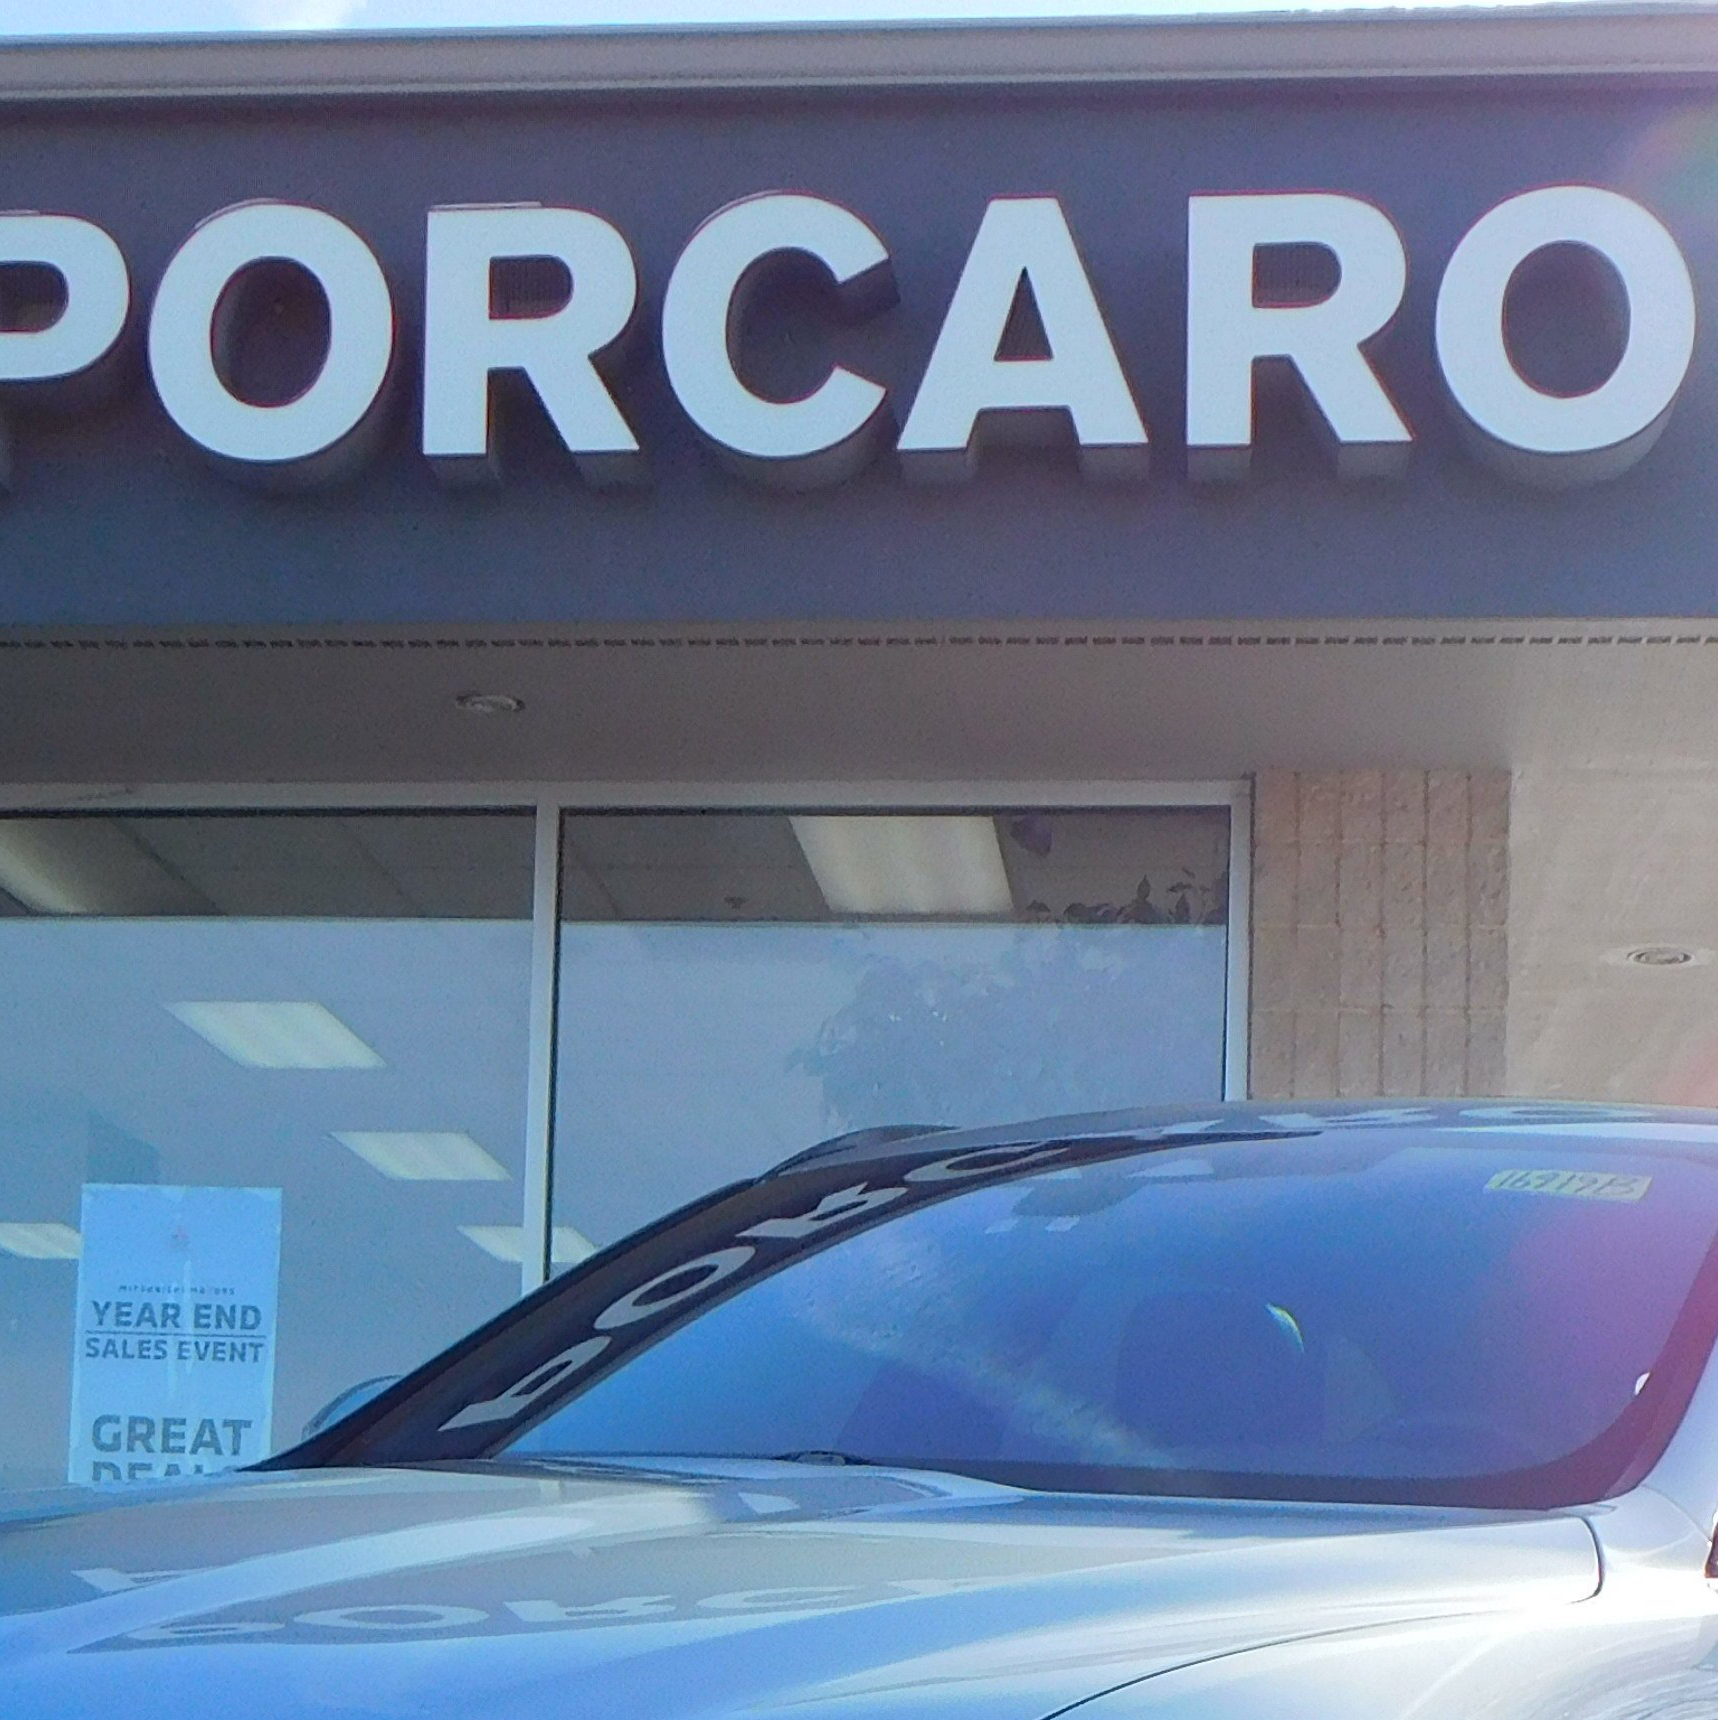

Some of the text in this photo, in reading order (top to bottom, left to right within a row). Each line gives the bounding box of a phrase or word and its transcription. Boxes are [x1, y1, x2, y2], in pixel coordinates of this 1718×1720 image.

[91, 1299, 262, 1331] YEAR END
[85, 1336, 265, 1363] SALES EVENT
[91, 1413, 253, 1457] GREAT
